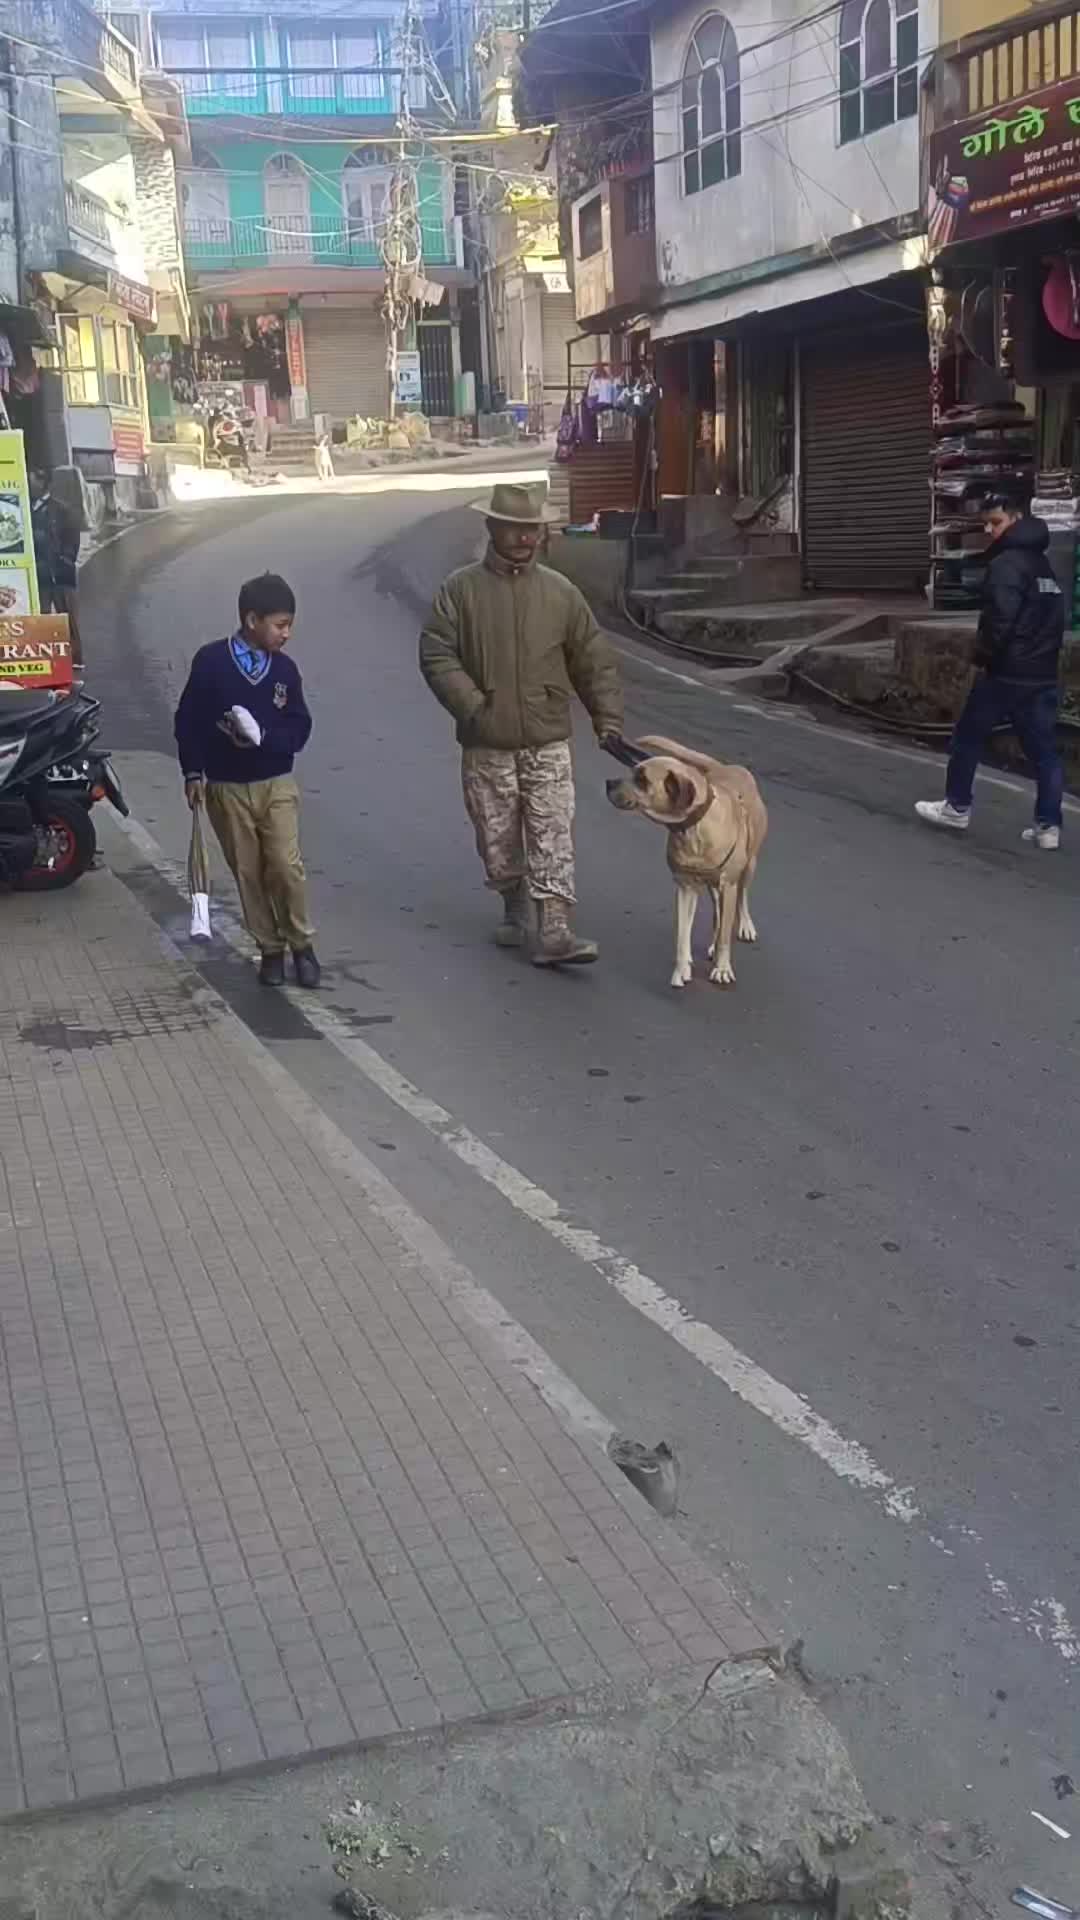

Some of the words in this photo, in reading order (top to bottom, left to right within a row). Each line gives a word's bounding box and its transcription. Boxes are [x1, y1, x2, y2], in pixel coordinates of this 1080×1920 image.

[959, 105, 1050, 158] गोले
[3, 641, 70, 658] RANT
[18, 663, 44, 672] VEG
